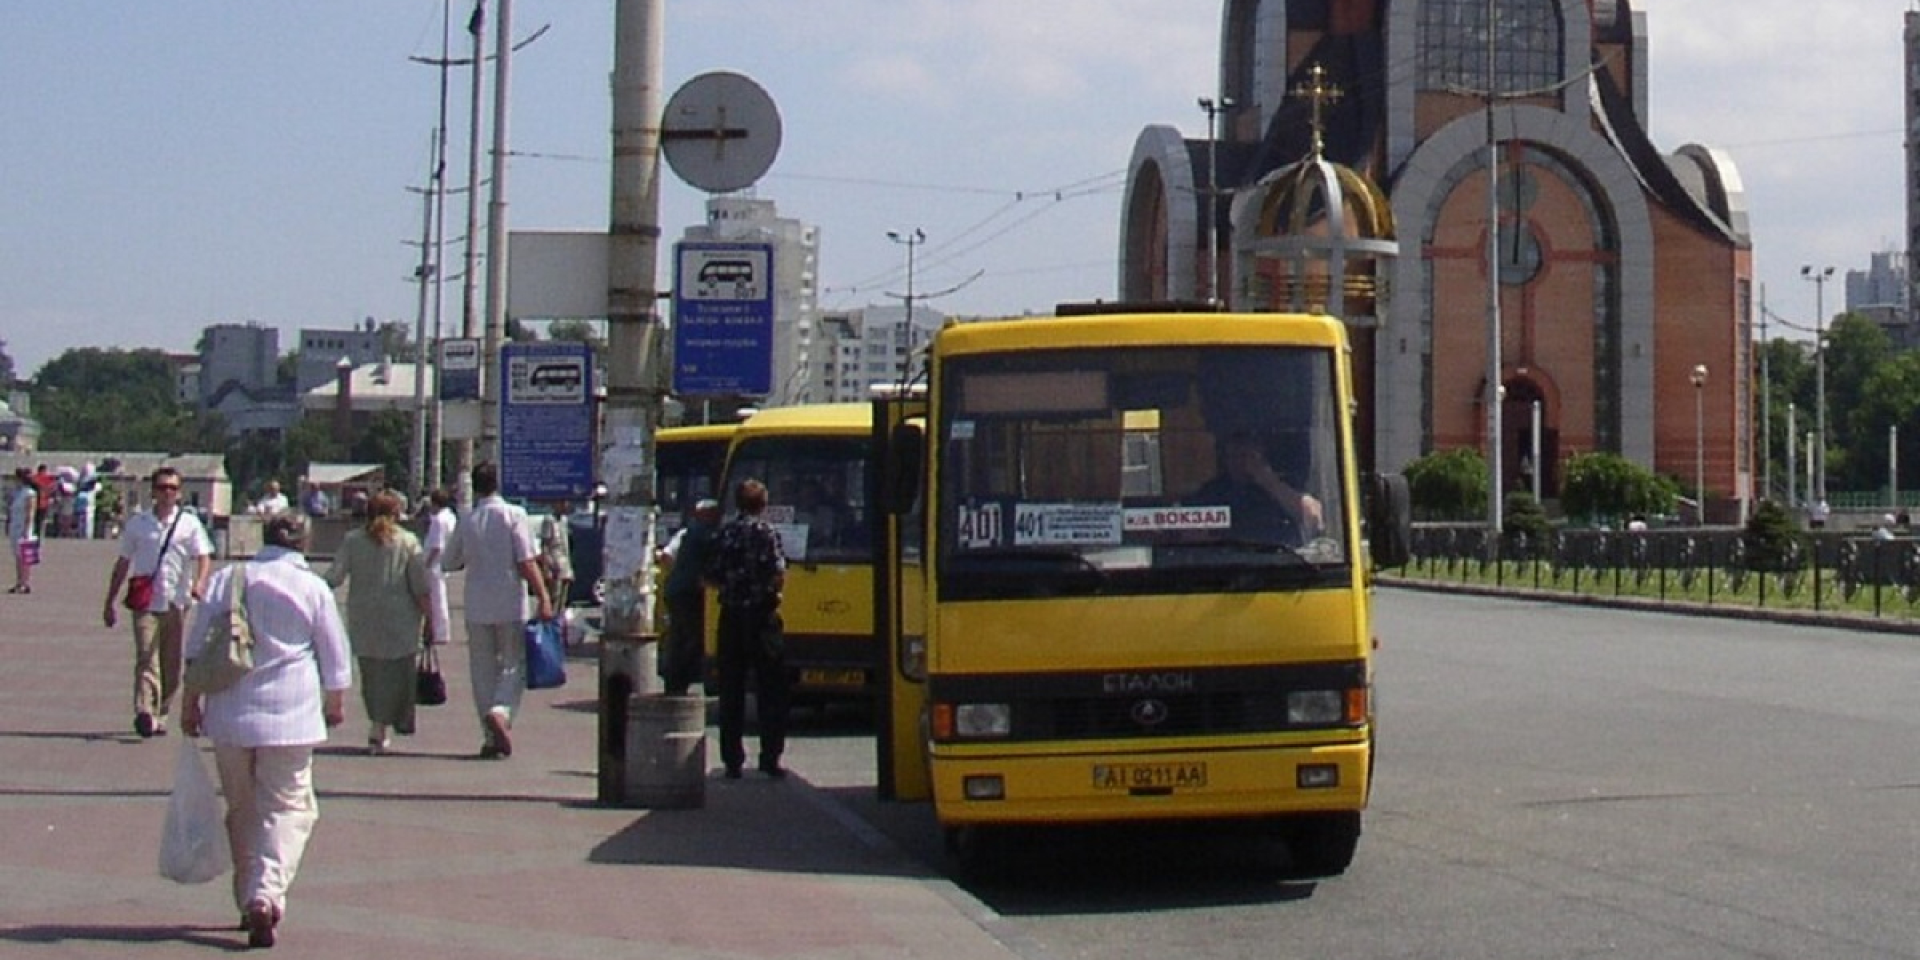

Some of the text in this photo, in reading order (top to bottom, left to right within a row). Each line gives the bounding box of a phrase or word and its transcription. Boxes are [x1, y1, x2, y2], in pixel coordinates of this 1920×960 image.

[959, 505, 1000, 546] 401
[1016, 511, 1043, 538] 401
[1154, 511, 1227, 525] ВОКЗАЛ
[1103, 672, 1193, 692] ЕТАЛОН
[1133, 765, 1173, 784] 0211
